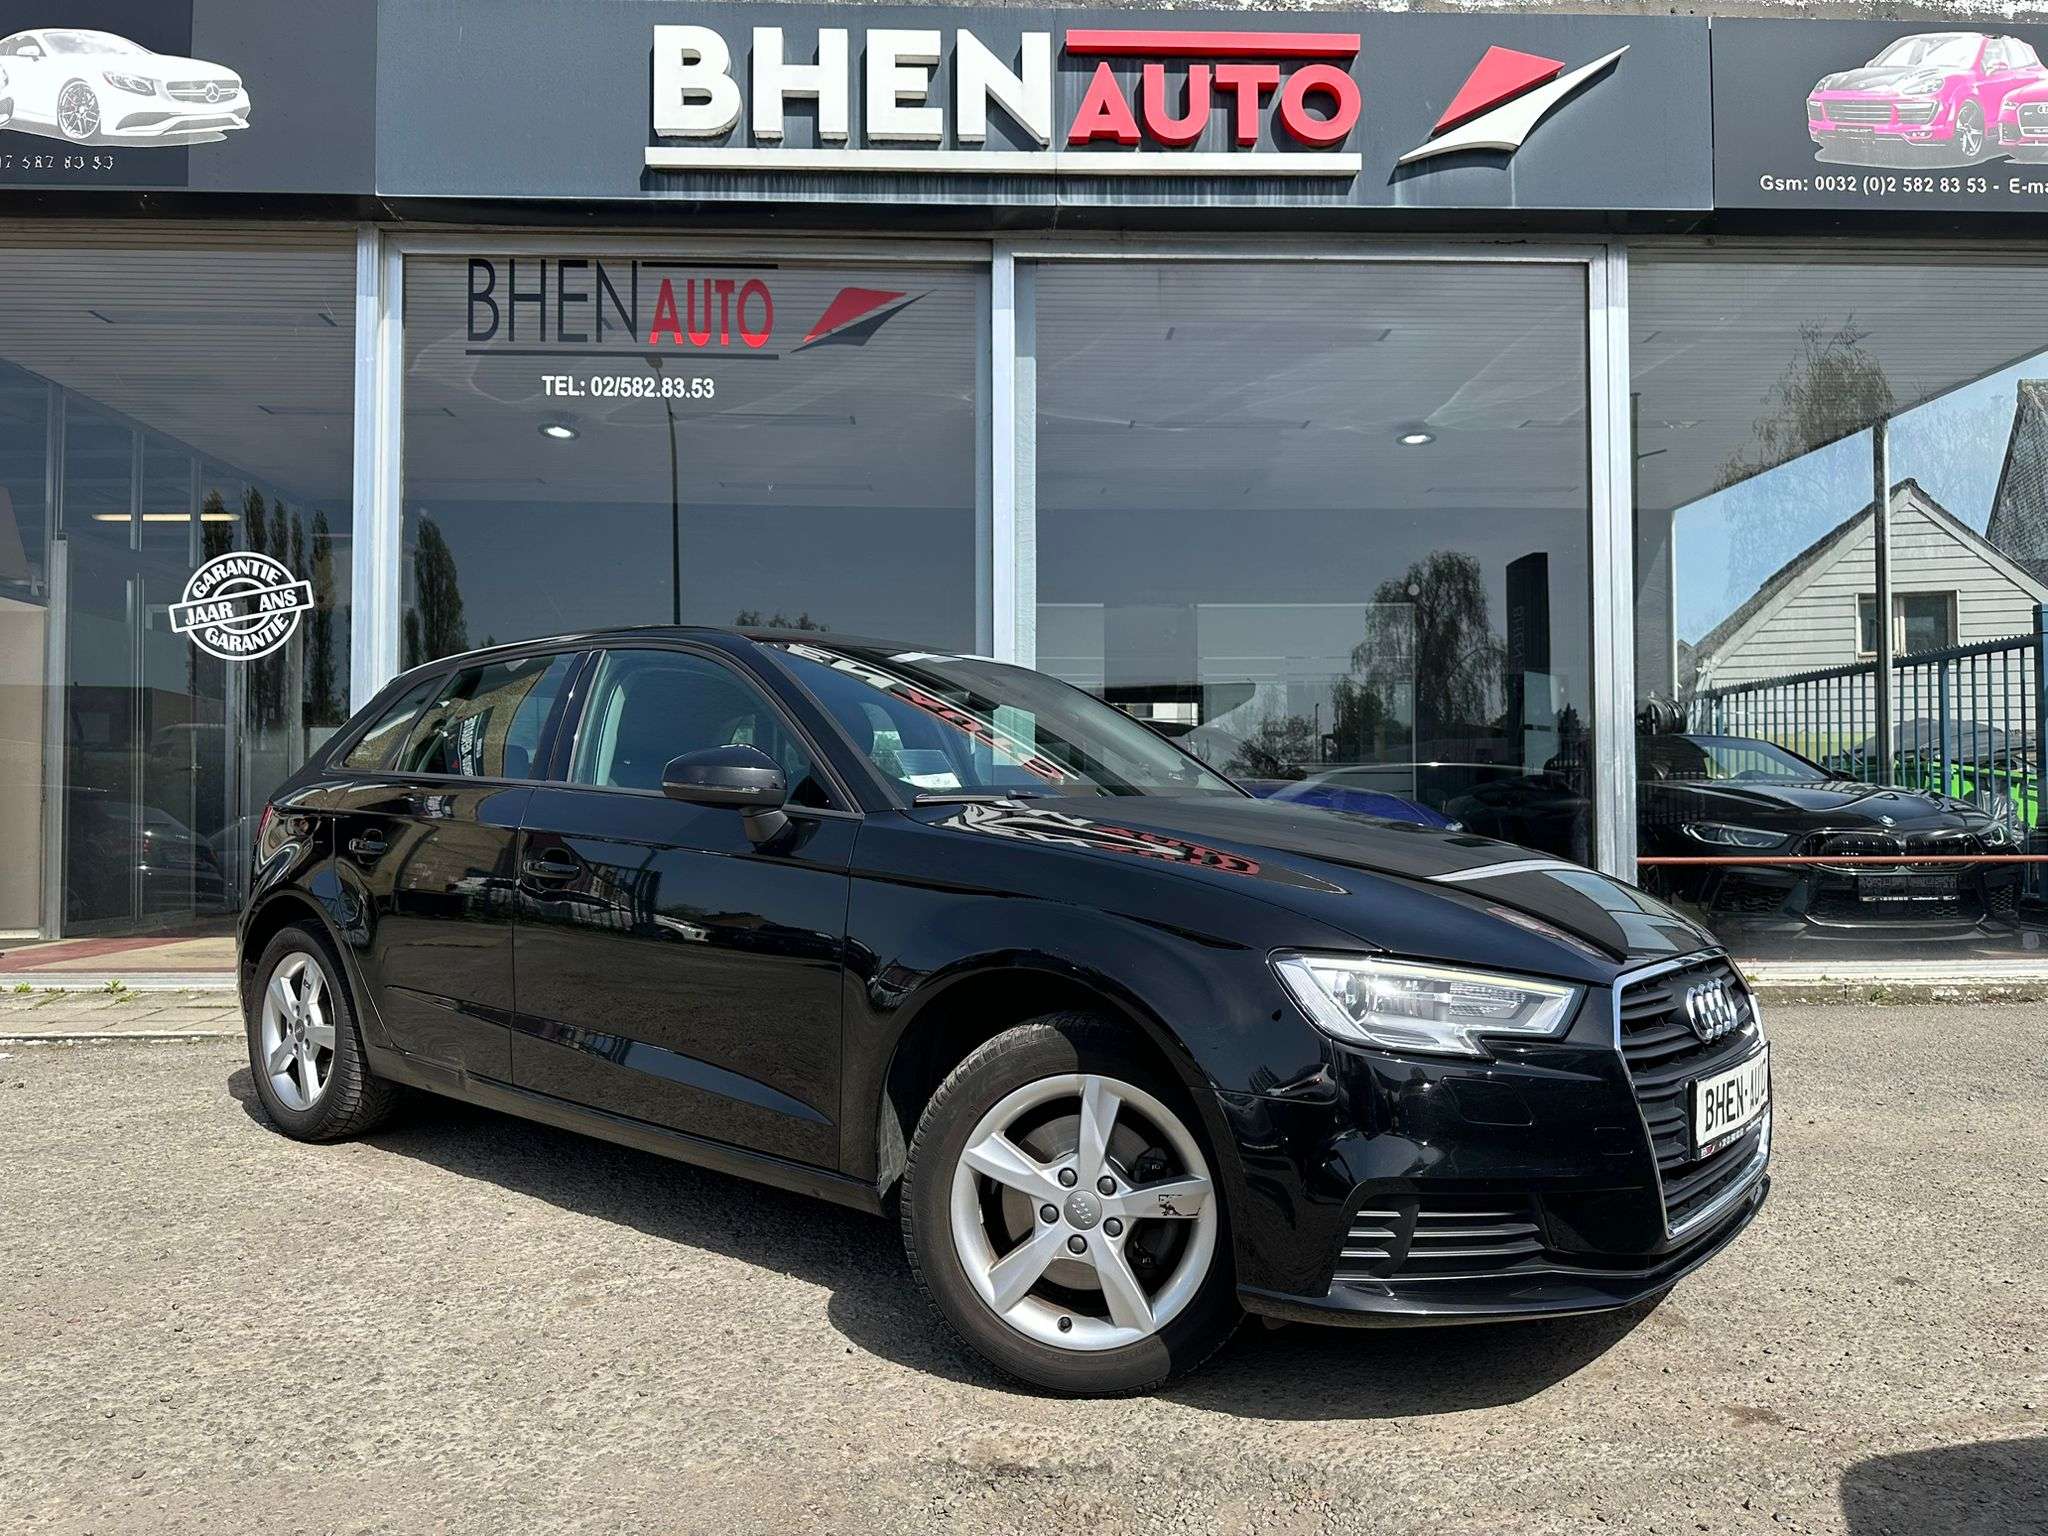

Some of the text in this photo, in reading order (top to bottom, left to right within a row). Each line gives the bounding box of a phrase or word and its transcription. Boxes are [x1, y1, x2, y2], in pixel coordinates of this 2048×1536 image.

[652, 24, 1362, 148] BHEN AUTO
[1759, 174, 1808, 192] Gsm:
[1814, 175, 1857, 192] 0032
[1862, 176, 1897, 196] (0)2
[1902, 177, 1934, 193] 582
[1939, 177, 1961, 193] 83
[1966, 177, 1988, 193] 53
[467, 258, 774, 348] BHEN AUTO
[541, 374, 716, 399] TEL: 02/582.83.53
[192, 559, 282, 599] GARANTIE
[185, 588, 298, 625] JAAR ANS
[204, 613, 290, 652] GARANTIE
[1705, 1057, 1766, 1132] BHEN-AUO
